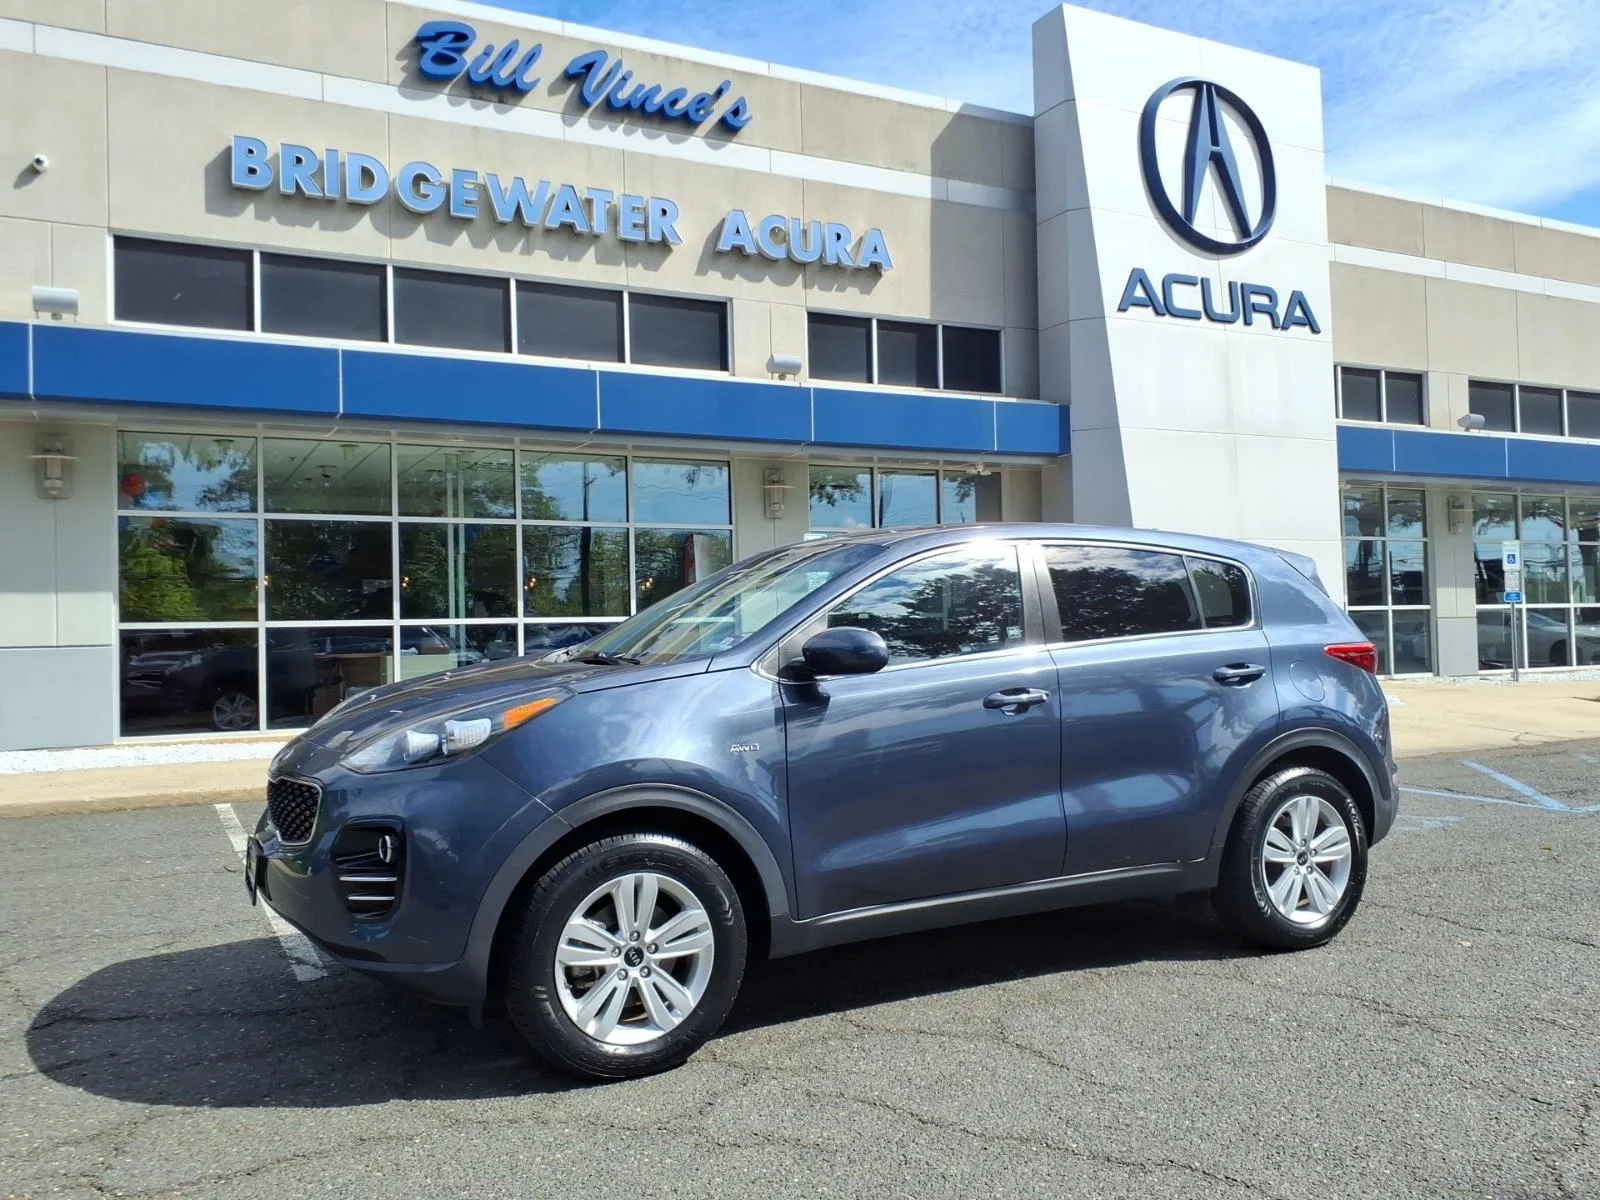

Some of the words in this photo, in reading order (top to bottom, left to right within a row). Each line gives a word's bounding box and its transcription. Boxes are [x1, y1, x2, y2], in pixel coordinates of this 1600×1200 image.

[416, 20, 543, 93] Bill
[564, 49, 753, 132] Vince's
[231, 134, 682, 246] BRIDGEWATER
[716, 208, 893, 271] ACURA
[1117, 267, 1321, 334] ACURA
[729, 743, 760, 753] AWD
